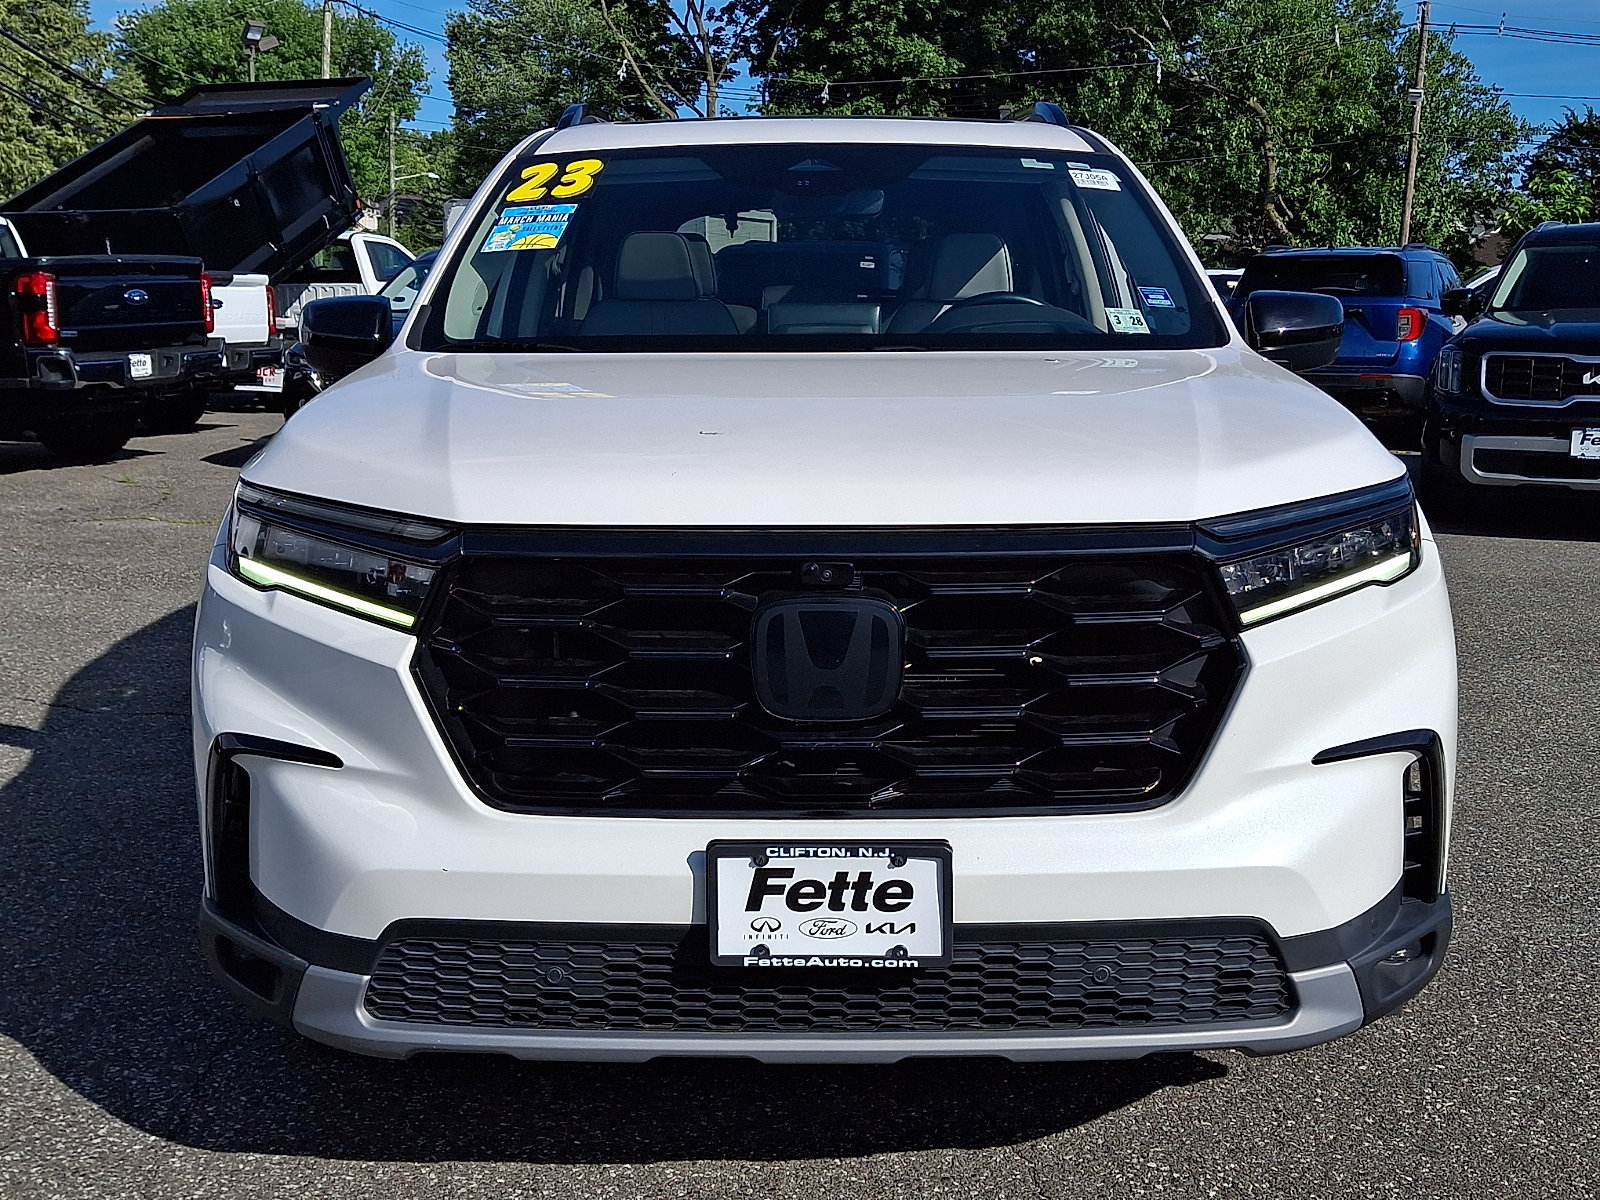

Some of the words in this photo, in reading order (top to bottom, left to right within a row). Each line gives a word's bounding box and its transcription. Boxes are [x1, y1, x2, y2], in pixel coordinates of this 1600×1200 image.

[506, 158, 605, 203] 23
[497, 215, 534, 226] MARCH
[535, 213, 570, 223] MANIA
[1113, 314, 1122, 325] 3
[1129, 315, 1144, 326] 28
[765, 847, 851, 858] CLIFTON,
[858, 847, 896, 858] N.J.
[744, 867, 915, 913] Fette
[808, 919, 848, 937] Ford
[743, 956, 919, 968] FetteAuto.com
